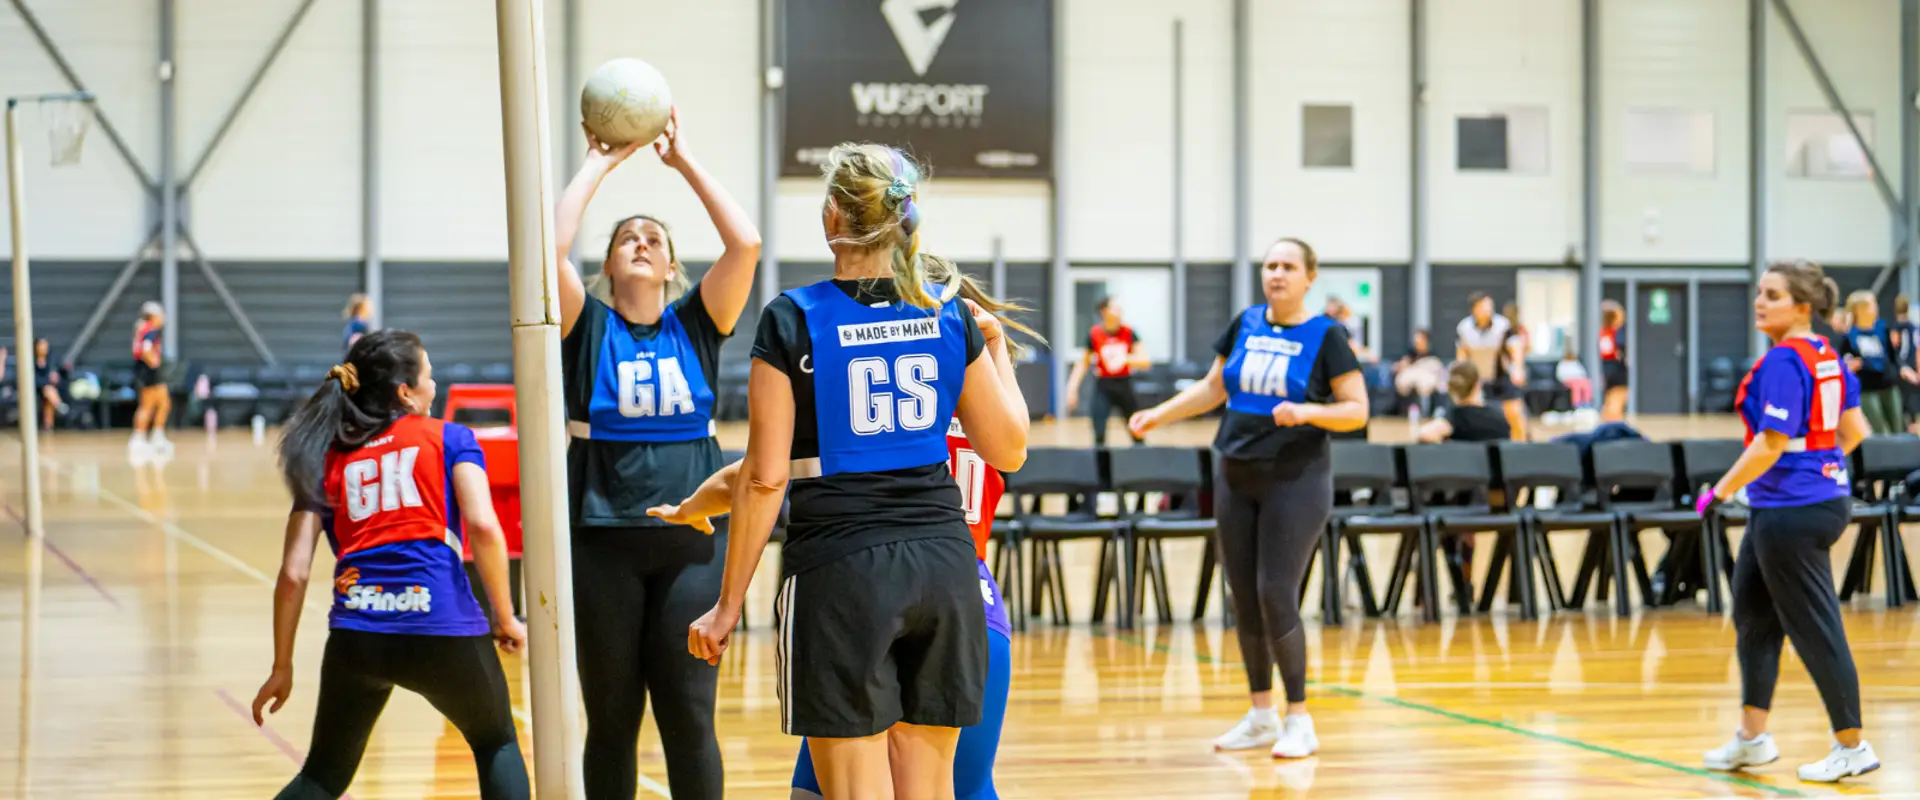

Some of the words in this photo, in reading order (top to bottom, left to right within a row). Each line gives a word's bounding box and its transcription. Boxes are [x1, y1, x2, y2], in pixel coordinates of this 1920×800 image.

[855, 325, 888, 341] MADE
[890, 326, 901, 337] BY
[617, 356, 695, 418] GA
[848, 353, 939, 436] GS
[343, 446, 424, 522] GK
[946, 447, 986, 525] D
